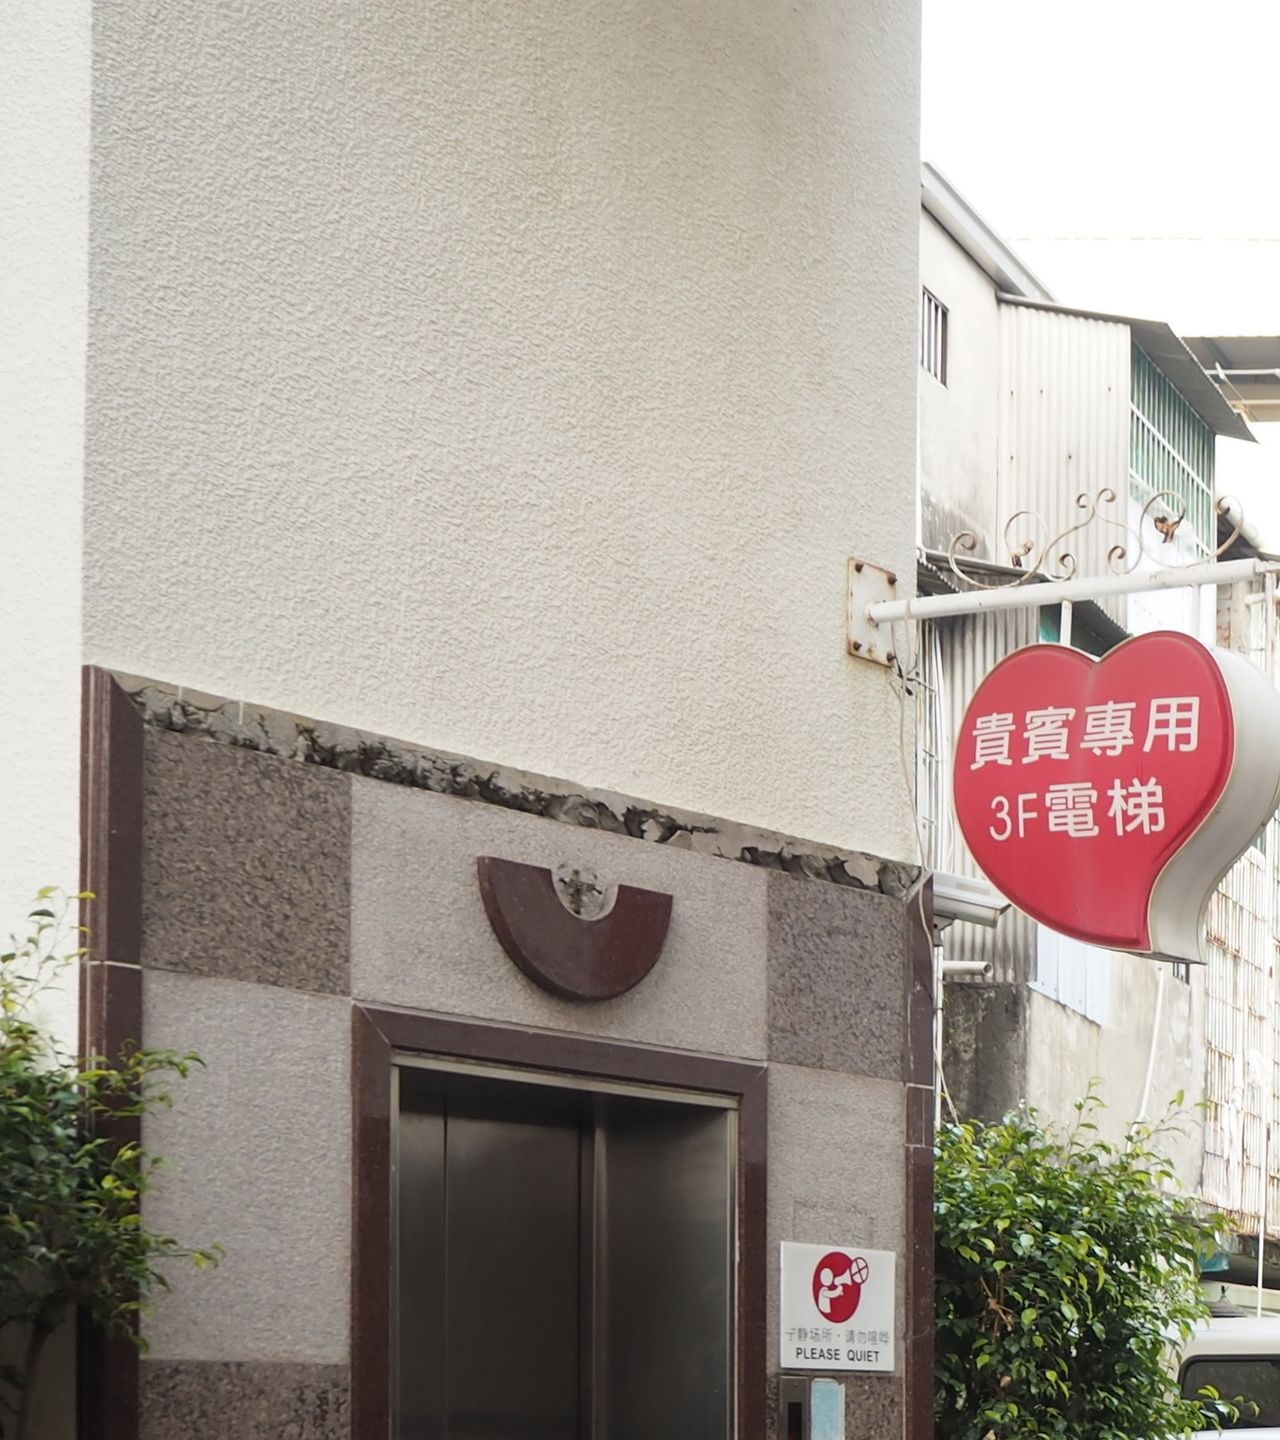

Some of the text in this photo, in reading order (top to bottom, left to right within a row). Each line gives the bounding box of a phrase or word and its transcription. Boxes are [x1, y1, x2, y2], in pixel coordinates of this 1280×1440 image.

[970, 696, 1201, 770] 貴賓專用
[989, 776, 1166, 842] 3F電梯
[796, 1347, 880, 1362] PLEASE QUIET
